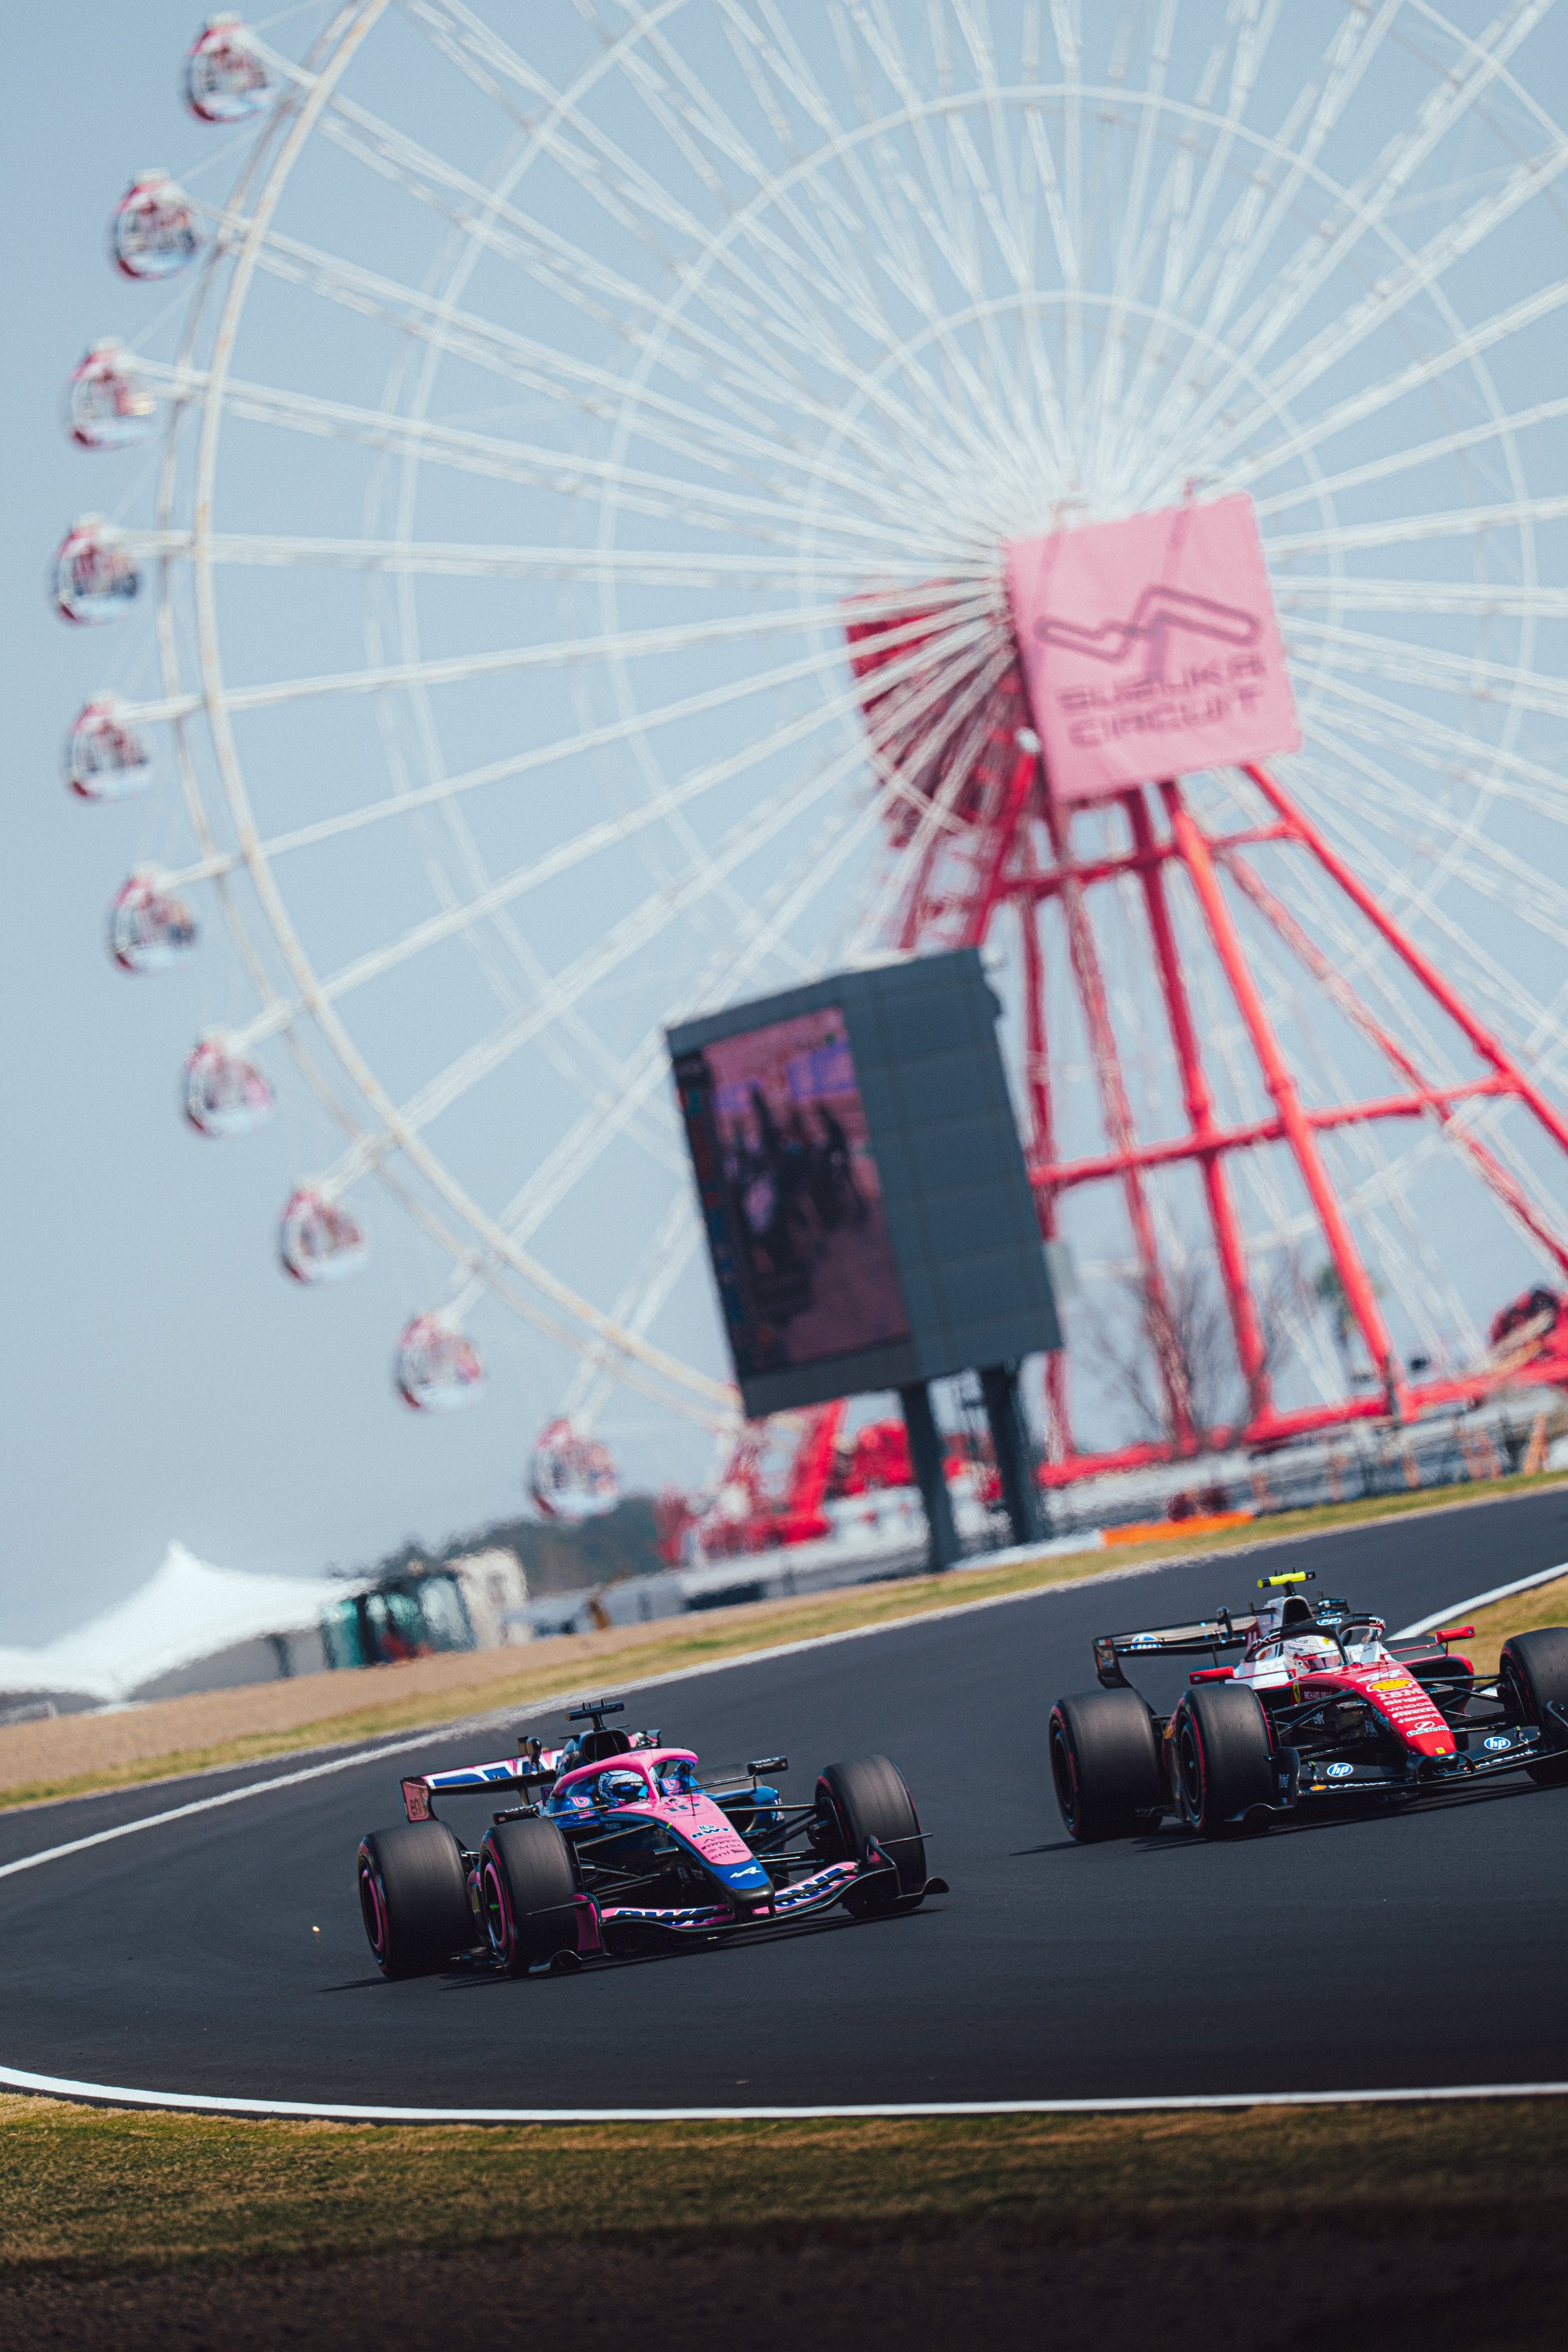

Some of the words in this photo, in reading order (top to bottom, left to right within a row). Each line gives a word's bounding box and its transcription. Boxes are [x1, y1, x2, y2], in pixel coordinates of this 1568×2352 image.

[1069, 686, 1261, 748] CIRCUIT
[1356, 1669, 1403, 1682] 44
[1377, 1688, 1424, 1701] IBM
[1489, 1737, 1507, 1750] hp
[1331, 1763, 1350, 1777] hp
[691, 1828, 730, 1839] BWT
[711, 1850, 730, 1860] eni
